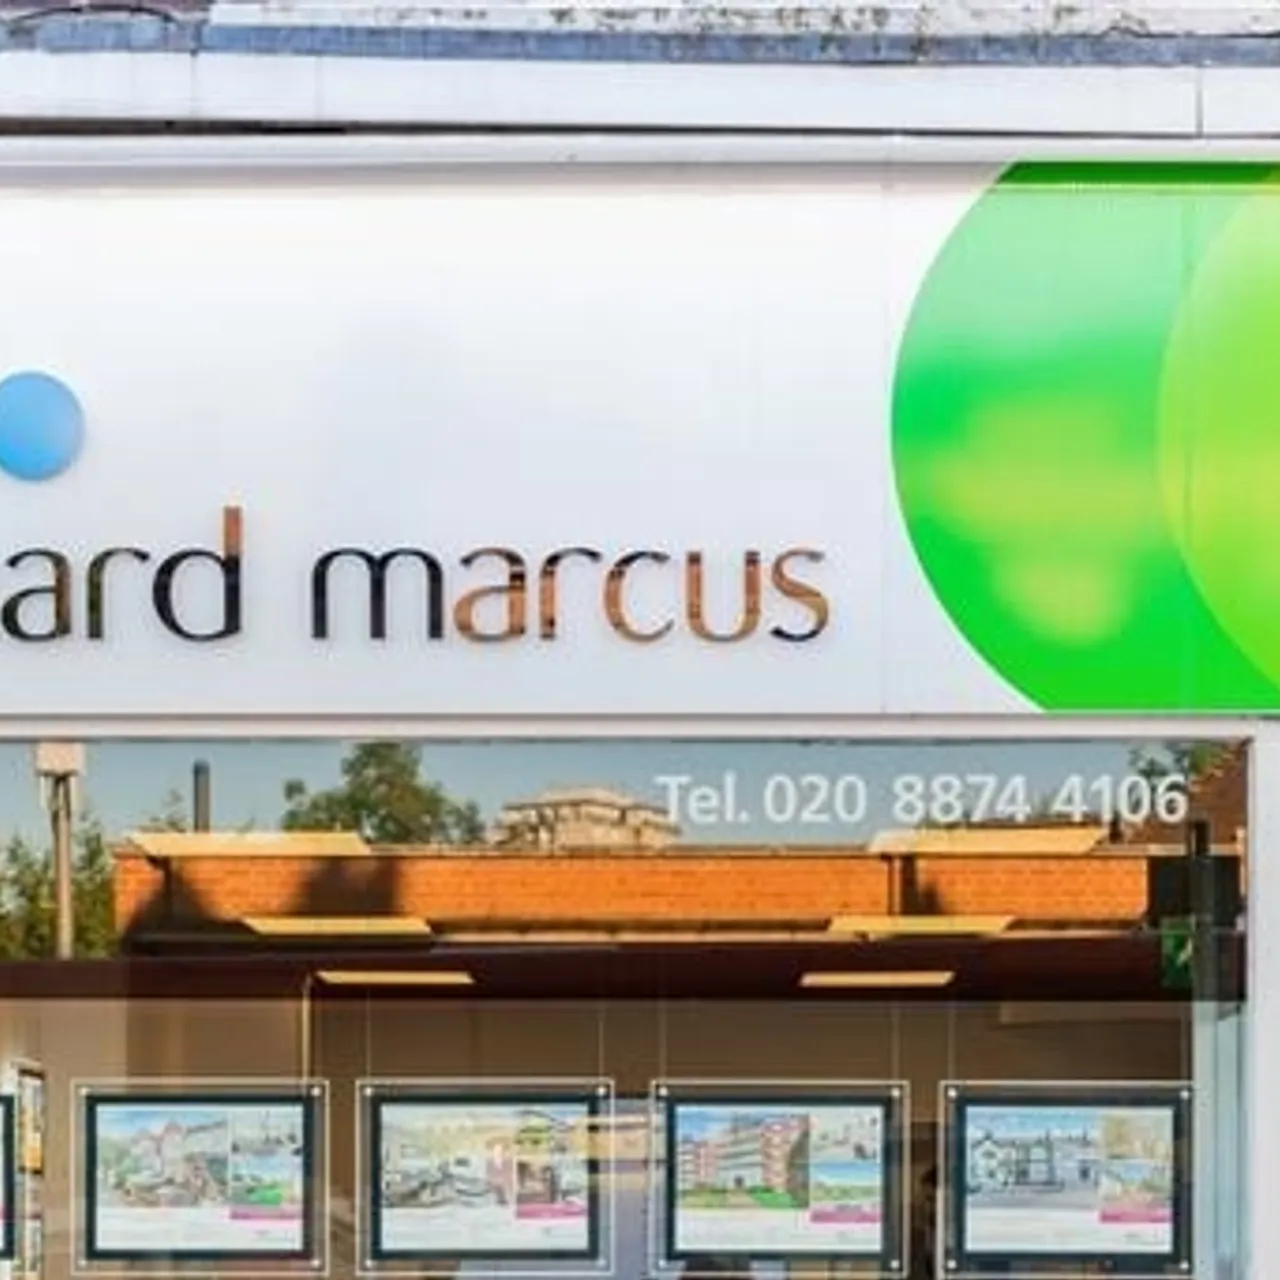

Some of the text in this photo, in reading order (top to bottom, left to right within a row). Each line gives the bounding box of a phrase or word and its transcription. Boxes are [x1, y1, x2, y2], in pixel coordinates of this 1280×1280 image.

[310, 546, 830, 644] marcus
[655, 771, 1188, 824] Tel. 020 8874 4106
